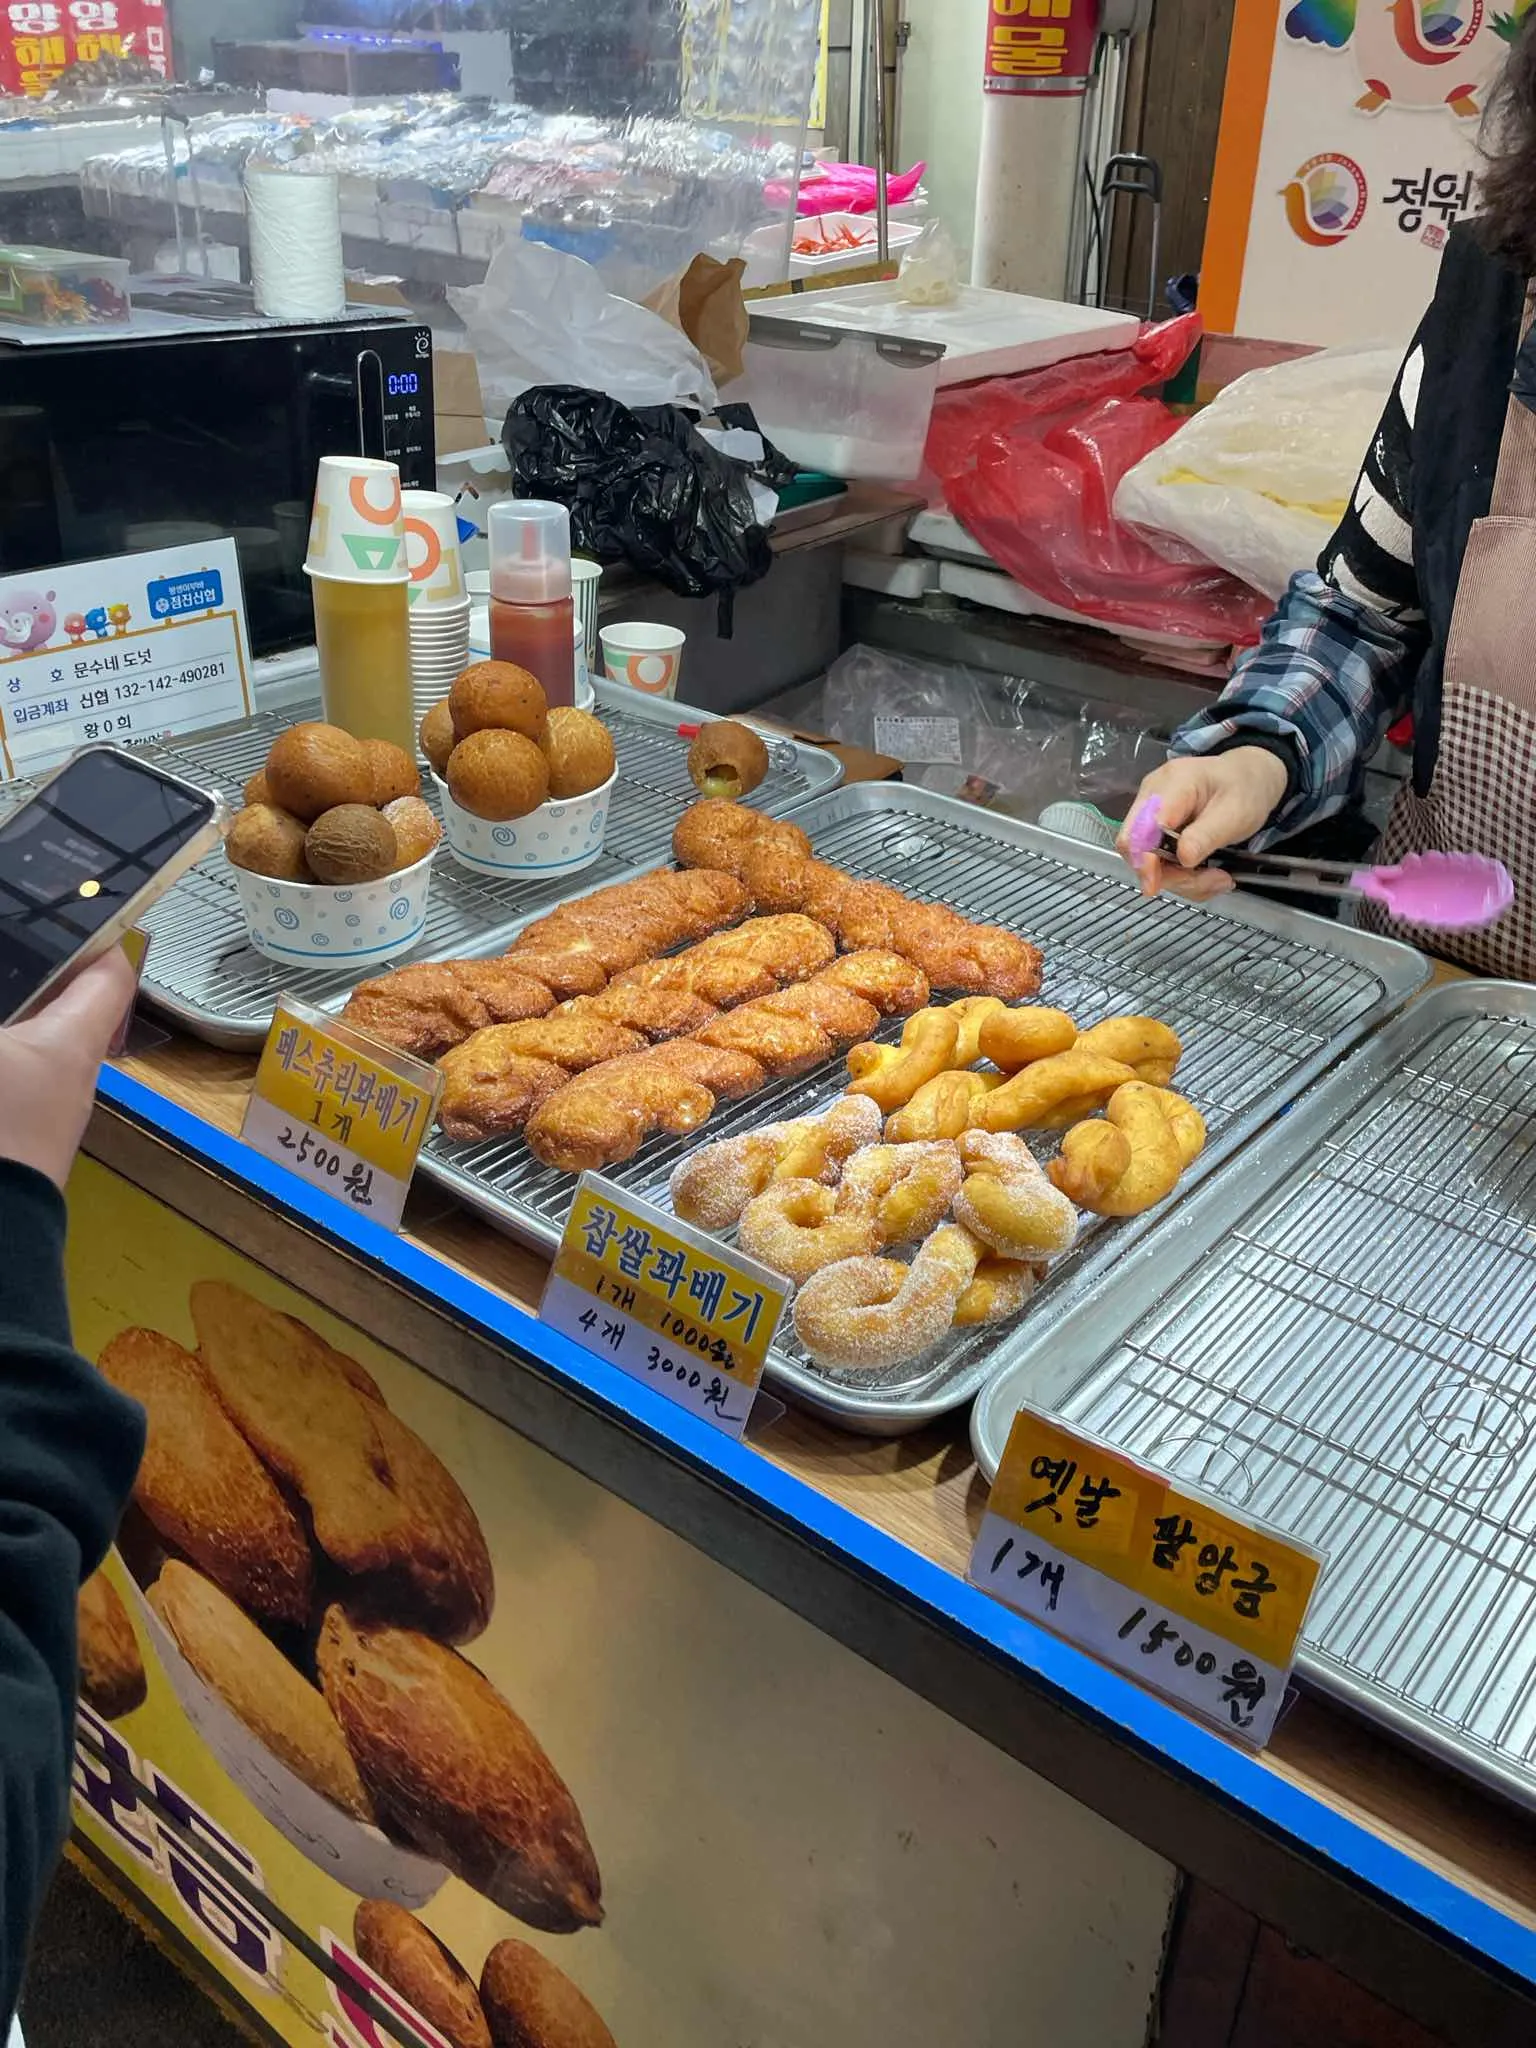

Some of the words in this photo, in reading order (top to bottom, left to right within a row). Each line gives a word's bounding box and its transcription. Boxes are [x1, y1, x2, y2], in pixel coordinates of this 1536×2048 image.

[1382, 167, 1480, 233] 정원
[388, 373, 418, 395] 0:00
[13, 698, 70, 724] 입금계좌
[80, 690, 110, 710] 신협
[115, 662, 226, 700] 132-142-490281
[74, 655, 120, 680] 문수네
[124, 648, 153, 665] 도넛
[84, 723, 99, 739] 황
[581, 1205, 764, 1344] 찹쌀꽈배기
[1024, 1455, 1121, 1529] 옛날
